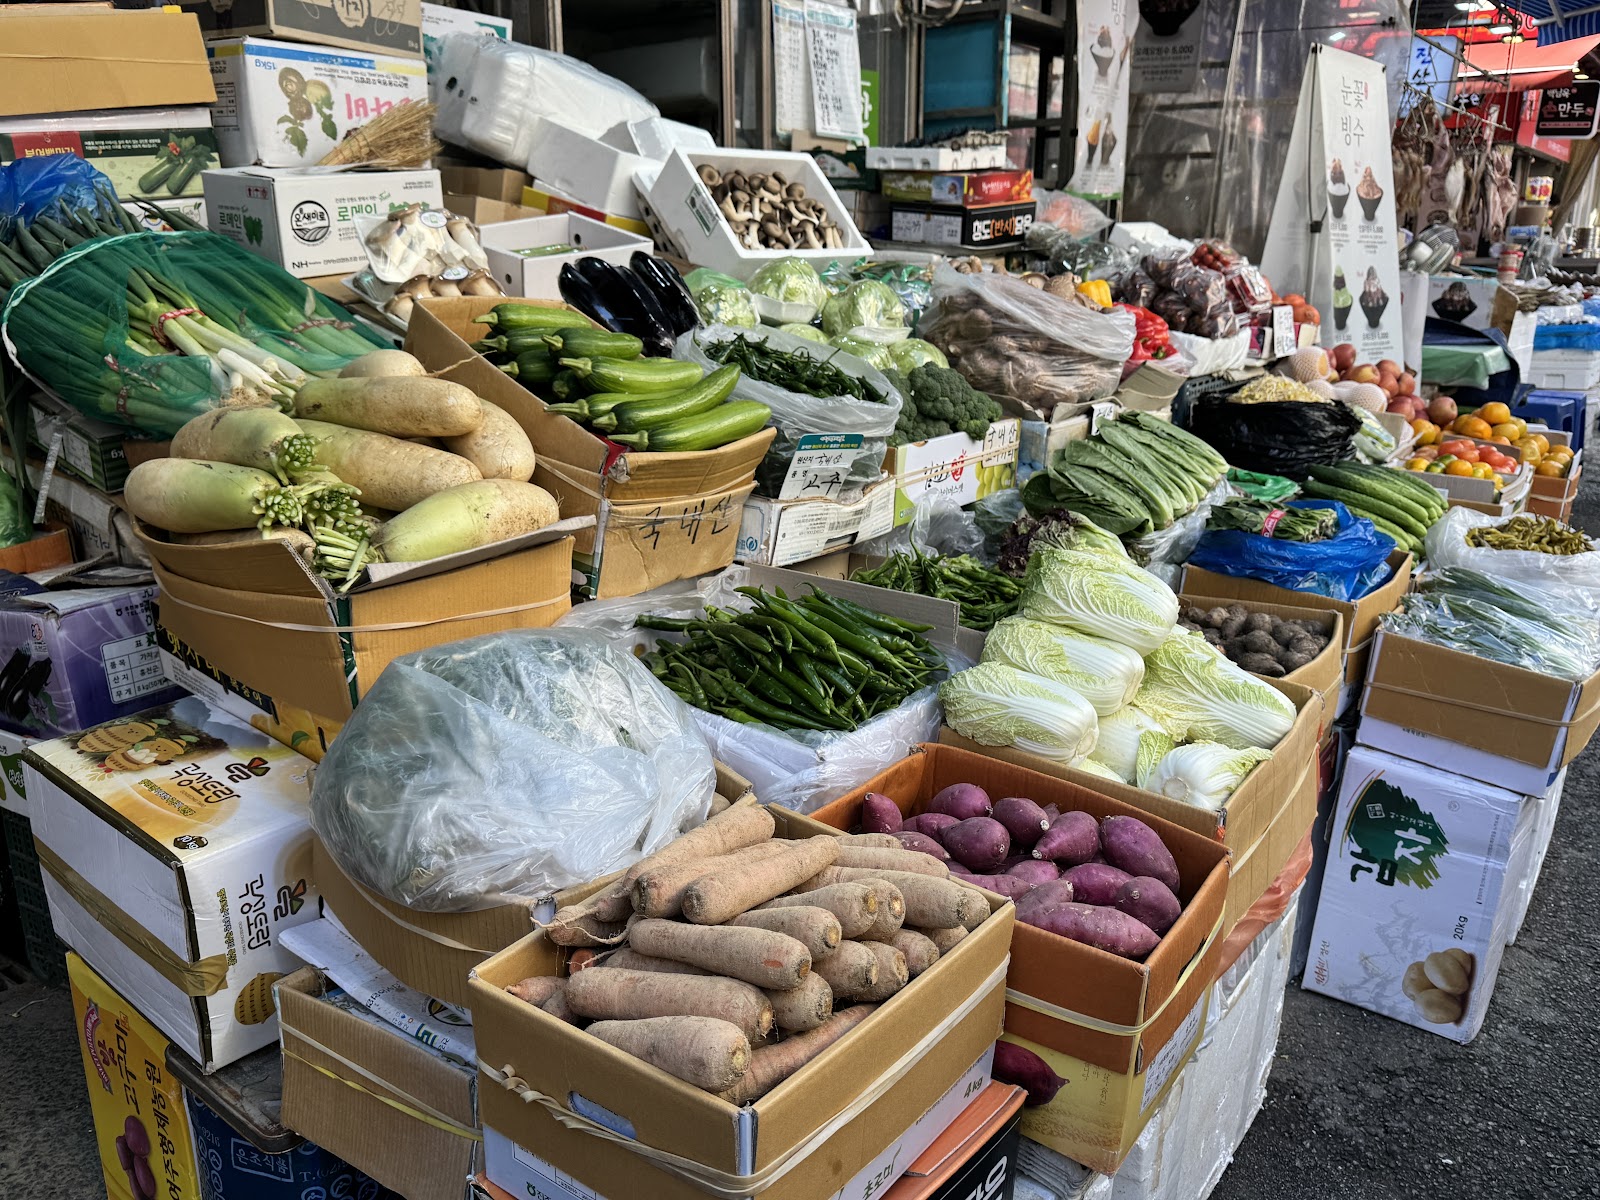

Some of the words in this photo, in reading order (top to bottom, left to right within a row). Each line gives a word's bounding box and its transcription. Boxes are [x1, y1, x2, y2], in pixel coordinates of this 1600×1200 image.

[255, 58, 277, 70] 15kg
[1340, 75, 1365, 109] 눈꽃
[1340, 115, 1365, 148] 빙수
[219, 211, 242, 229] 로메인
[292, 260, 309, 269] NH
[988, 423, 1018, 450] 국내산
[797, 455, 814, 464] 원산지
[802, 471, 842, 496] 고추
[639, 494, 732, 550] 국내산
[1349, 826, 1432, 888] 감자
[1453, 914, 1468, 941] 20kg
[115, 1018, 141, 1115] 고구마
[144, 1058, 184, 1200] 여주형제농원
[236, 1147, 289, 1175] 온조식품
